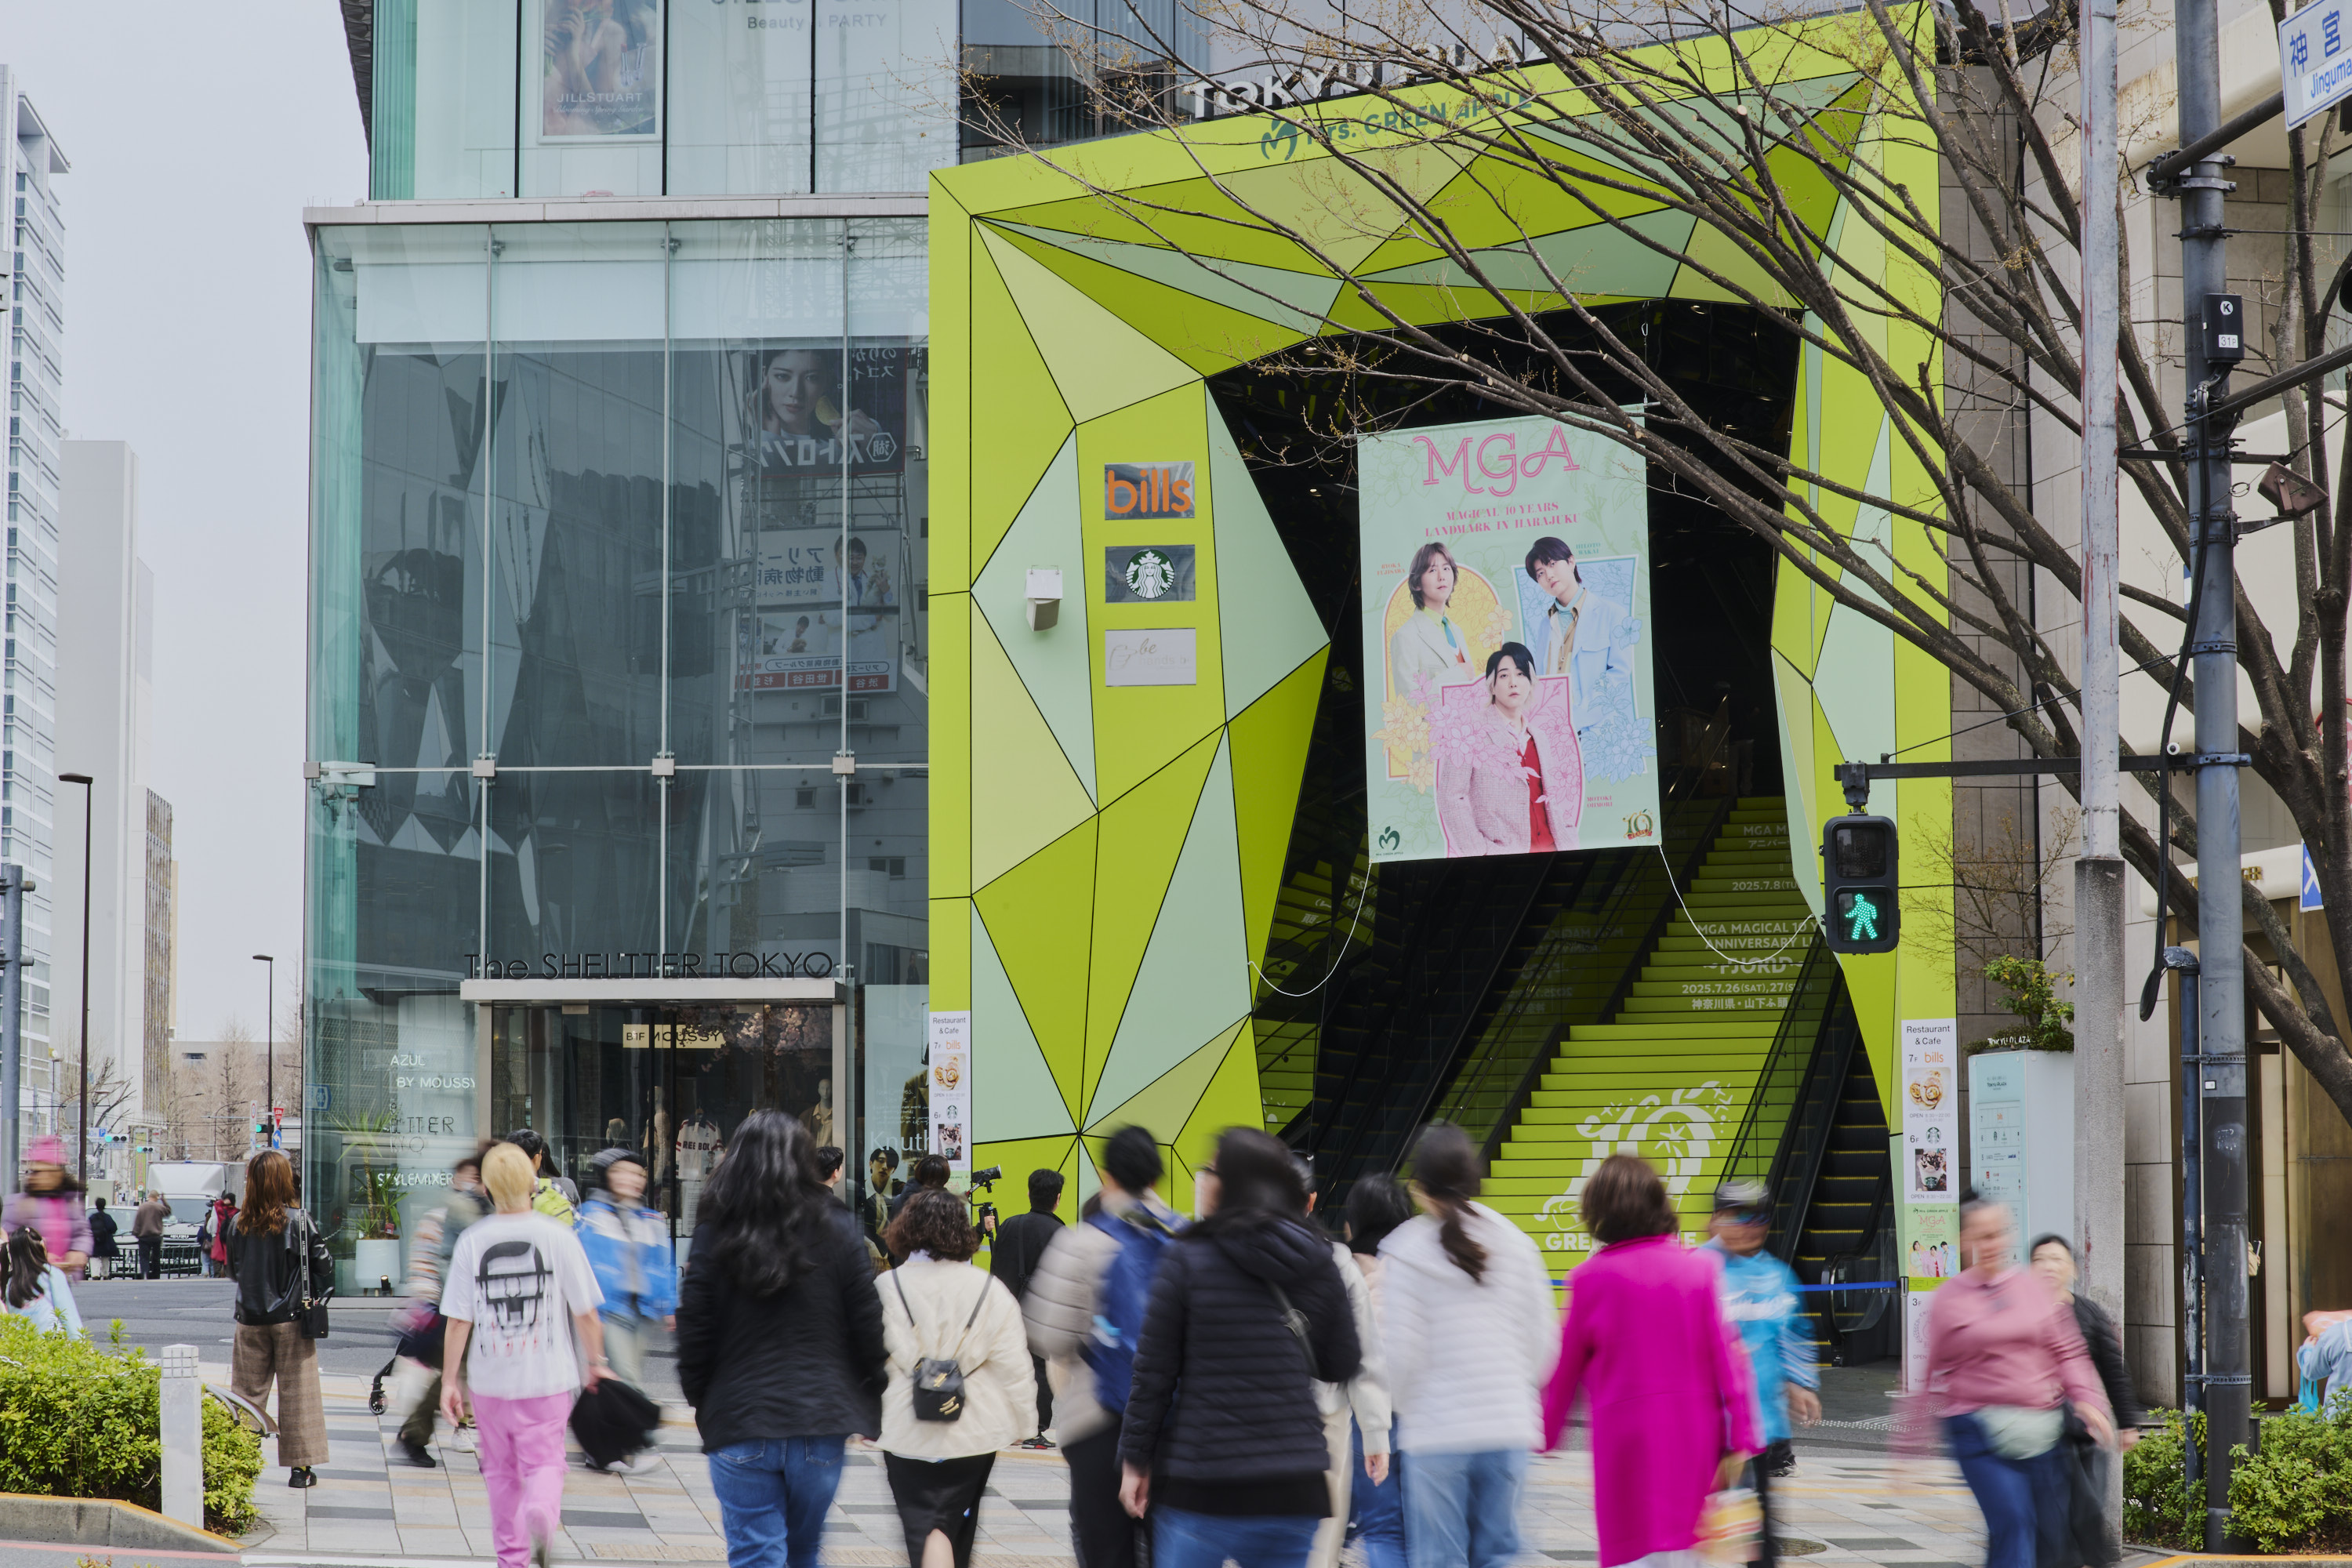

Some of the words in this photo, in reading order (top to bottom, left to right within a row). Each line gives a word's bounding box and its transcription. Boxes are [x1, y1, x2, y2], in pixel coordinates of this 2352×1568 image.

[747, 16, 804, 31] Beauty
[828, 13, 887, 27] PARTY
[557, 93, 643, 103] JILLSTUART
[1412, 424, 1581, 498] MGA
[1108, 468, 1191, 514] bills
[1446, 505, 1500, 521] MAGICAL
[1505, 505, 1516, 516] 10
[1519, 501, 1559, 514] YEARS
[1425, 521, 1492, 538] LANDMARK
[1497, 520, 1510, 531] IN
[1514, 514, 1581, 529] HARAJUKU
[1743, 826, 1773, 837] MGA
[1748, 839, 1791, 849] アニバー
[1697, 923, 1728, 935] MGA
[1730, 922, 1789, 935] MAGICAL
[1704, 937, 1798, 950] ANNIVERSARY
[464, 953, 531, 980] The
[714, 951, 833, 979] TOKYO
[1906, 1025, 1951, 1033] Restaurant
[946, 1040, 961, 1050] bills
[390, 1054, 426, 1066] AZUL
[1924, 1051, 1944, 1063] bills
[396, 1076, 415, 1088] BY
[1918, 1214, 1947, 1228] MGA
